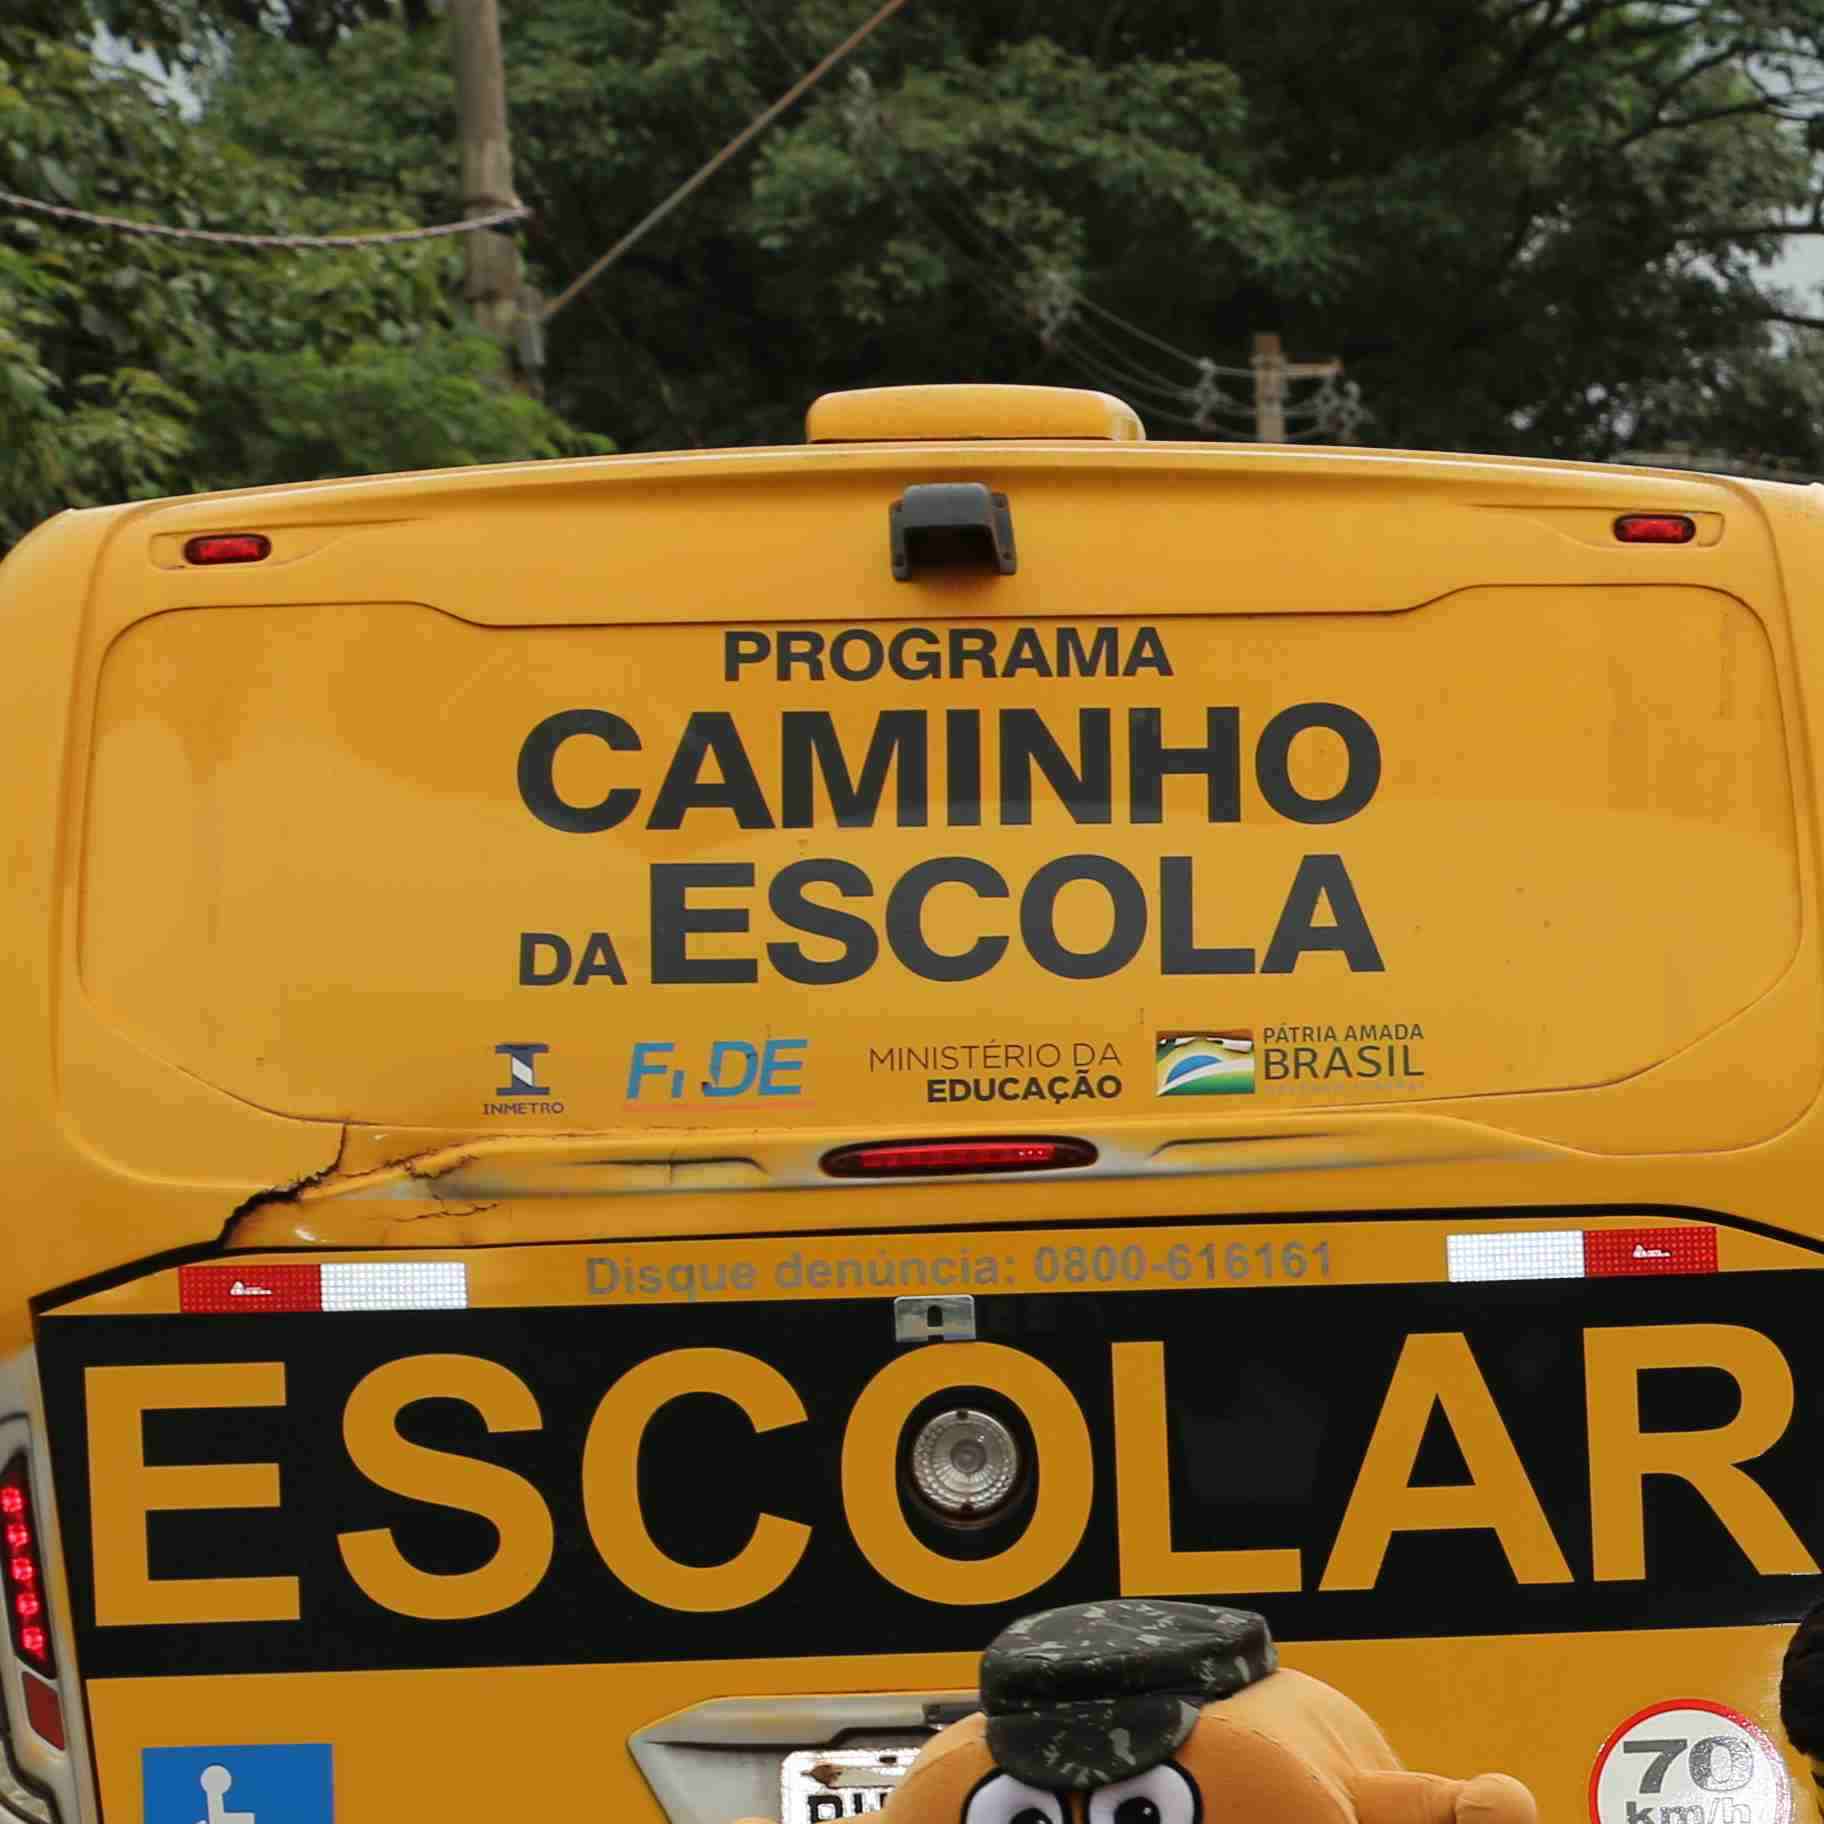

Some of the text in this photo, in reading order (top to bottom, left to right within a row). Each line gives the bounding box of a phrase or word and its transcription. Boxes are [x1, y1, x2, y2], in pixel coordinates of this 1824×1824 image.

[724, 626, 1173, 682] PROGRAMA
[516, 702, 1381, 833] CAMINHO
[518, 854, 1386, 986] DA ESCOLA
[869, 1039, 1122, 1072] MINISTÉRIO DA
[1263, 1021, 1425, 1042] PÁTRIA AMADA
[926, 1069, 1123, 1104] EDUCAÇÃO
[1263, 1045, 1425, 1080] BRASIL
[482, 1102, 565, 1116] INMETRO
[584, 1241, 1331, 1302] Disque denúncia: 0800-616161
[83, 1322, 1820, 1628] ESCOLAR
[1623, 1735, 1754, 1794] 70
